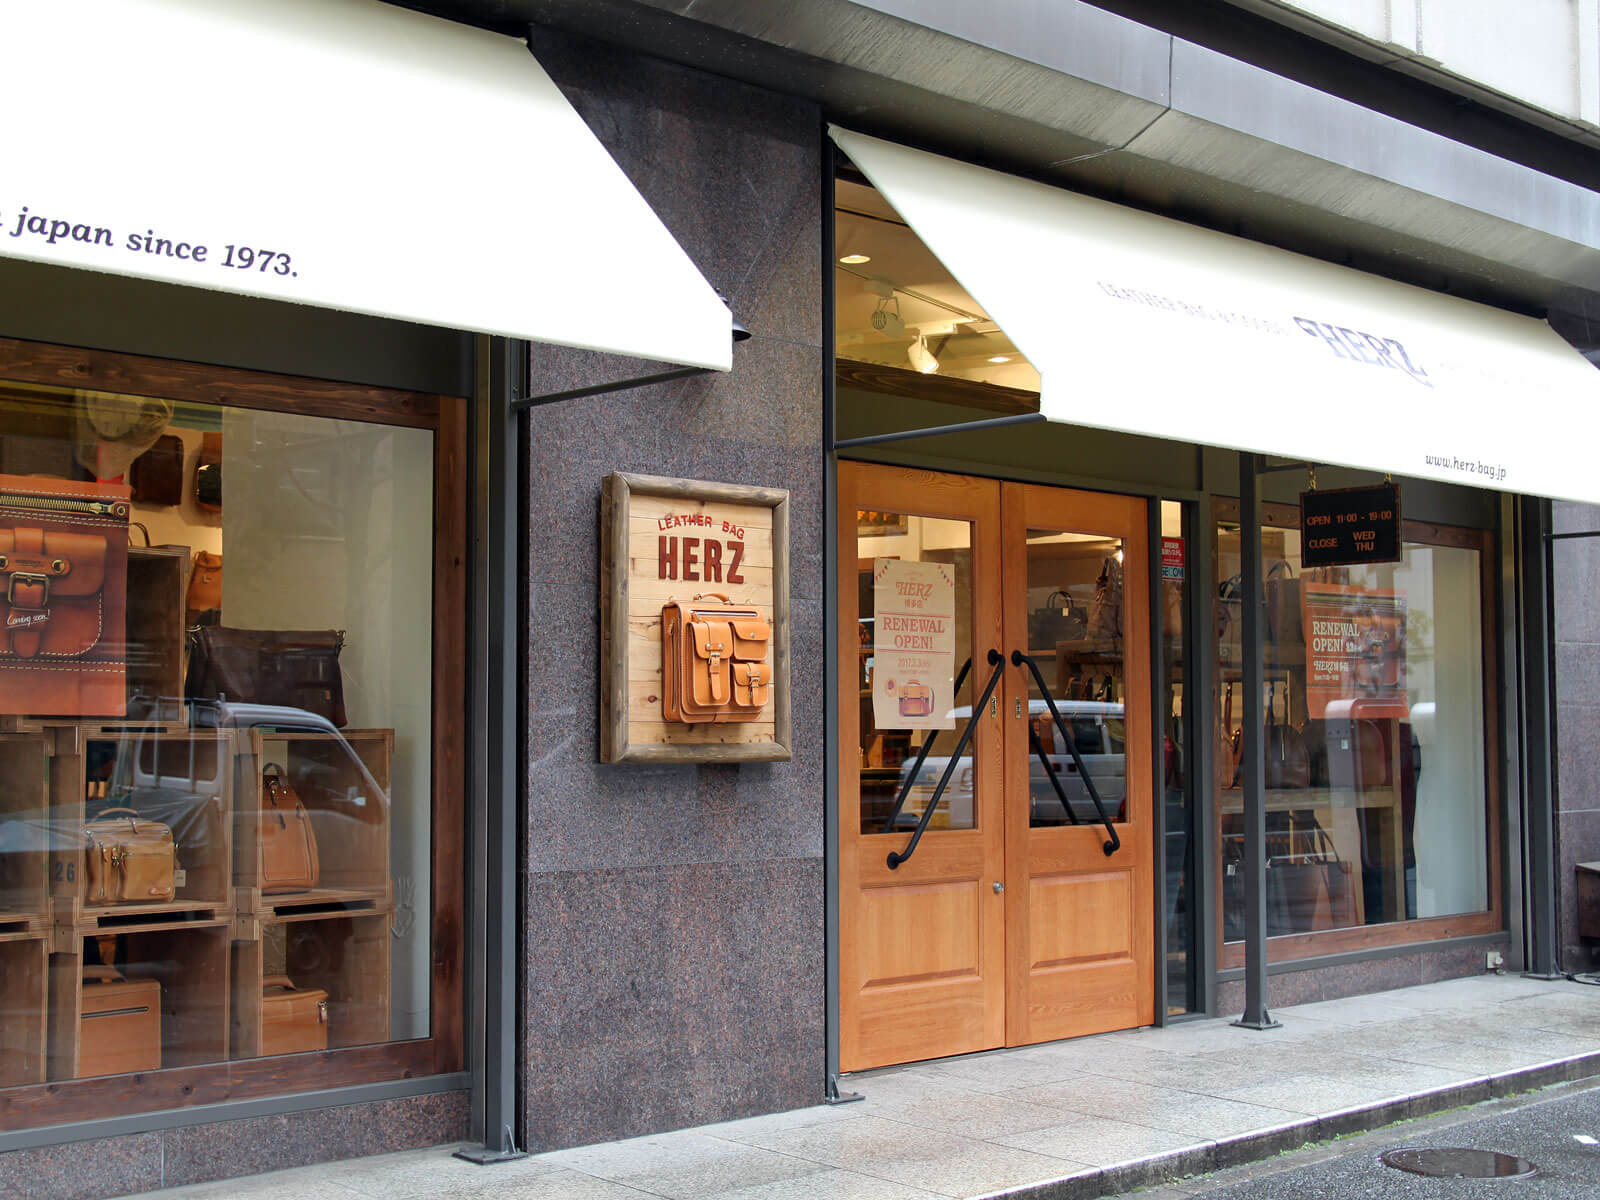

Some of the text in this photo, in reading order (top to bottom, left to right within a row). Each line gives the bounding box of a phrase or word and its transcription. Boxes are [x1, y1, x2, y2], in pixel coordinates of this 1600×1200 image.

[9, 206, 114, 246] japan
[126, 229, 208, 262] since
[221, 244, 298, 278] 1973.
[1293, 315, 1434, 388] HERZ
[658, 513, 744, 540] LEATHER BAG
[1307, 515, 1330, 526] OPEN
[1309, 538, 1337, 549] CLOSE
[1353, 531, 1376, 541] WED
[1356, 541, 1375, 552] THU
[658, 535, 745, 584] HERZ
[896, 581, 933, 600] HERZ
[7, 615, 31, 627] Coming
[883, 616, 945, 633] RENEWAL
[1312, 621, 1360, 637] RENEWAL
[894, 634, 933, 649] OPEN!
[1312, 637, 1343, 653] OPEN!
[55, 861, 76, 883] 26
